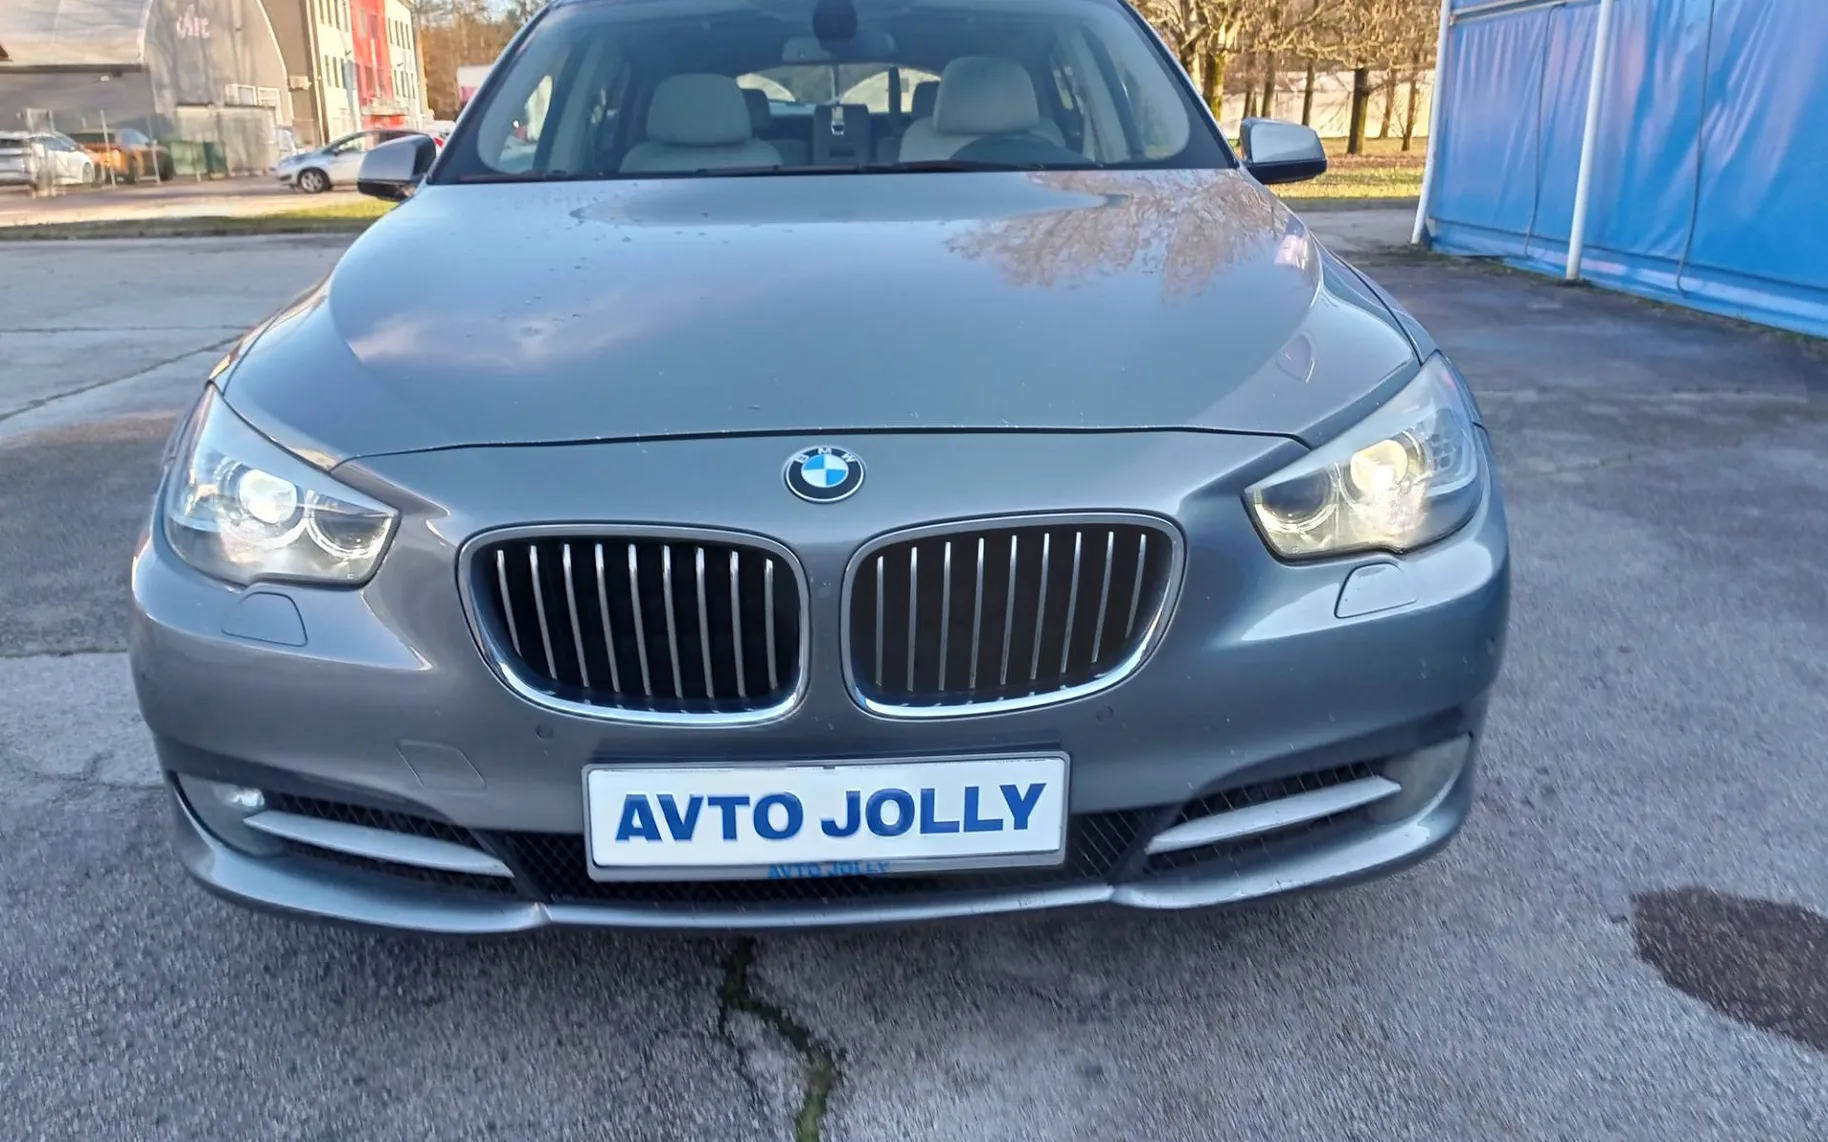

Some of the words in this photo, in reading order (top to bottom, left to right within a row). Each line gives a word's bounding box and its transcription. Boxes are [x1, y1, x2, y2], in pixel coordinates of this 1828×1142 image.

[794, 447, 856, 463] BMW
[615, 792, 804, 842] AVTO
[820, 782, 1047, 837] JOLLY
[767, 863, 820, 879] AVTO
[828, 860, 889, 877] JOLLY
